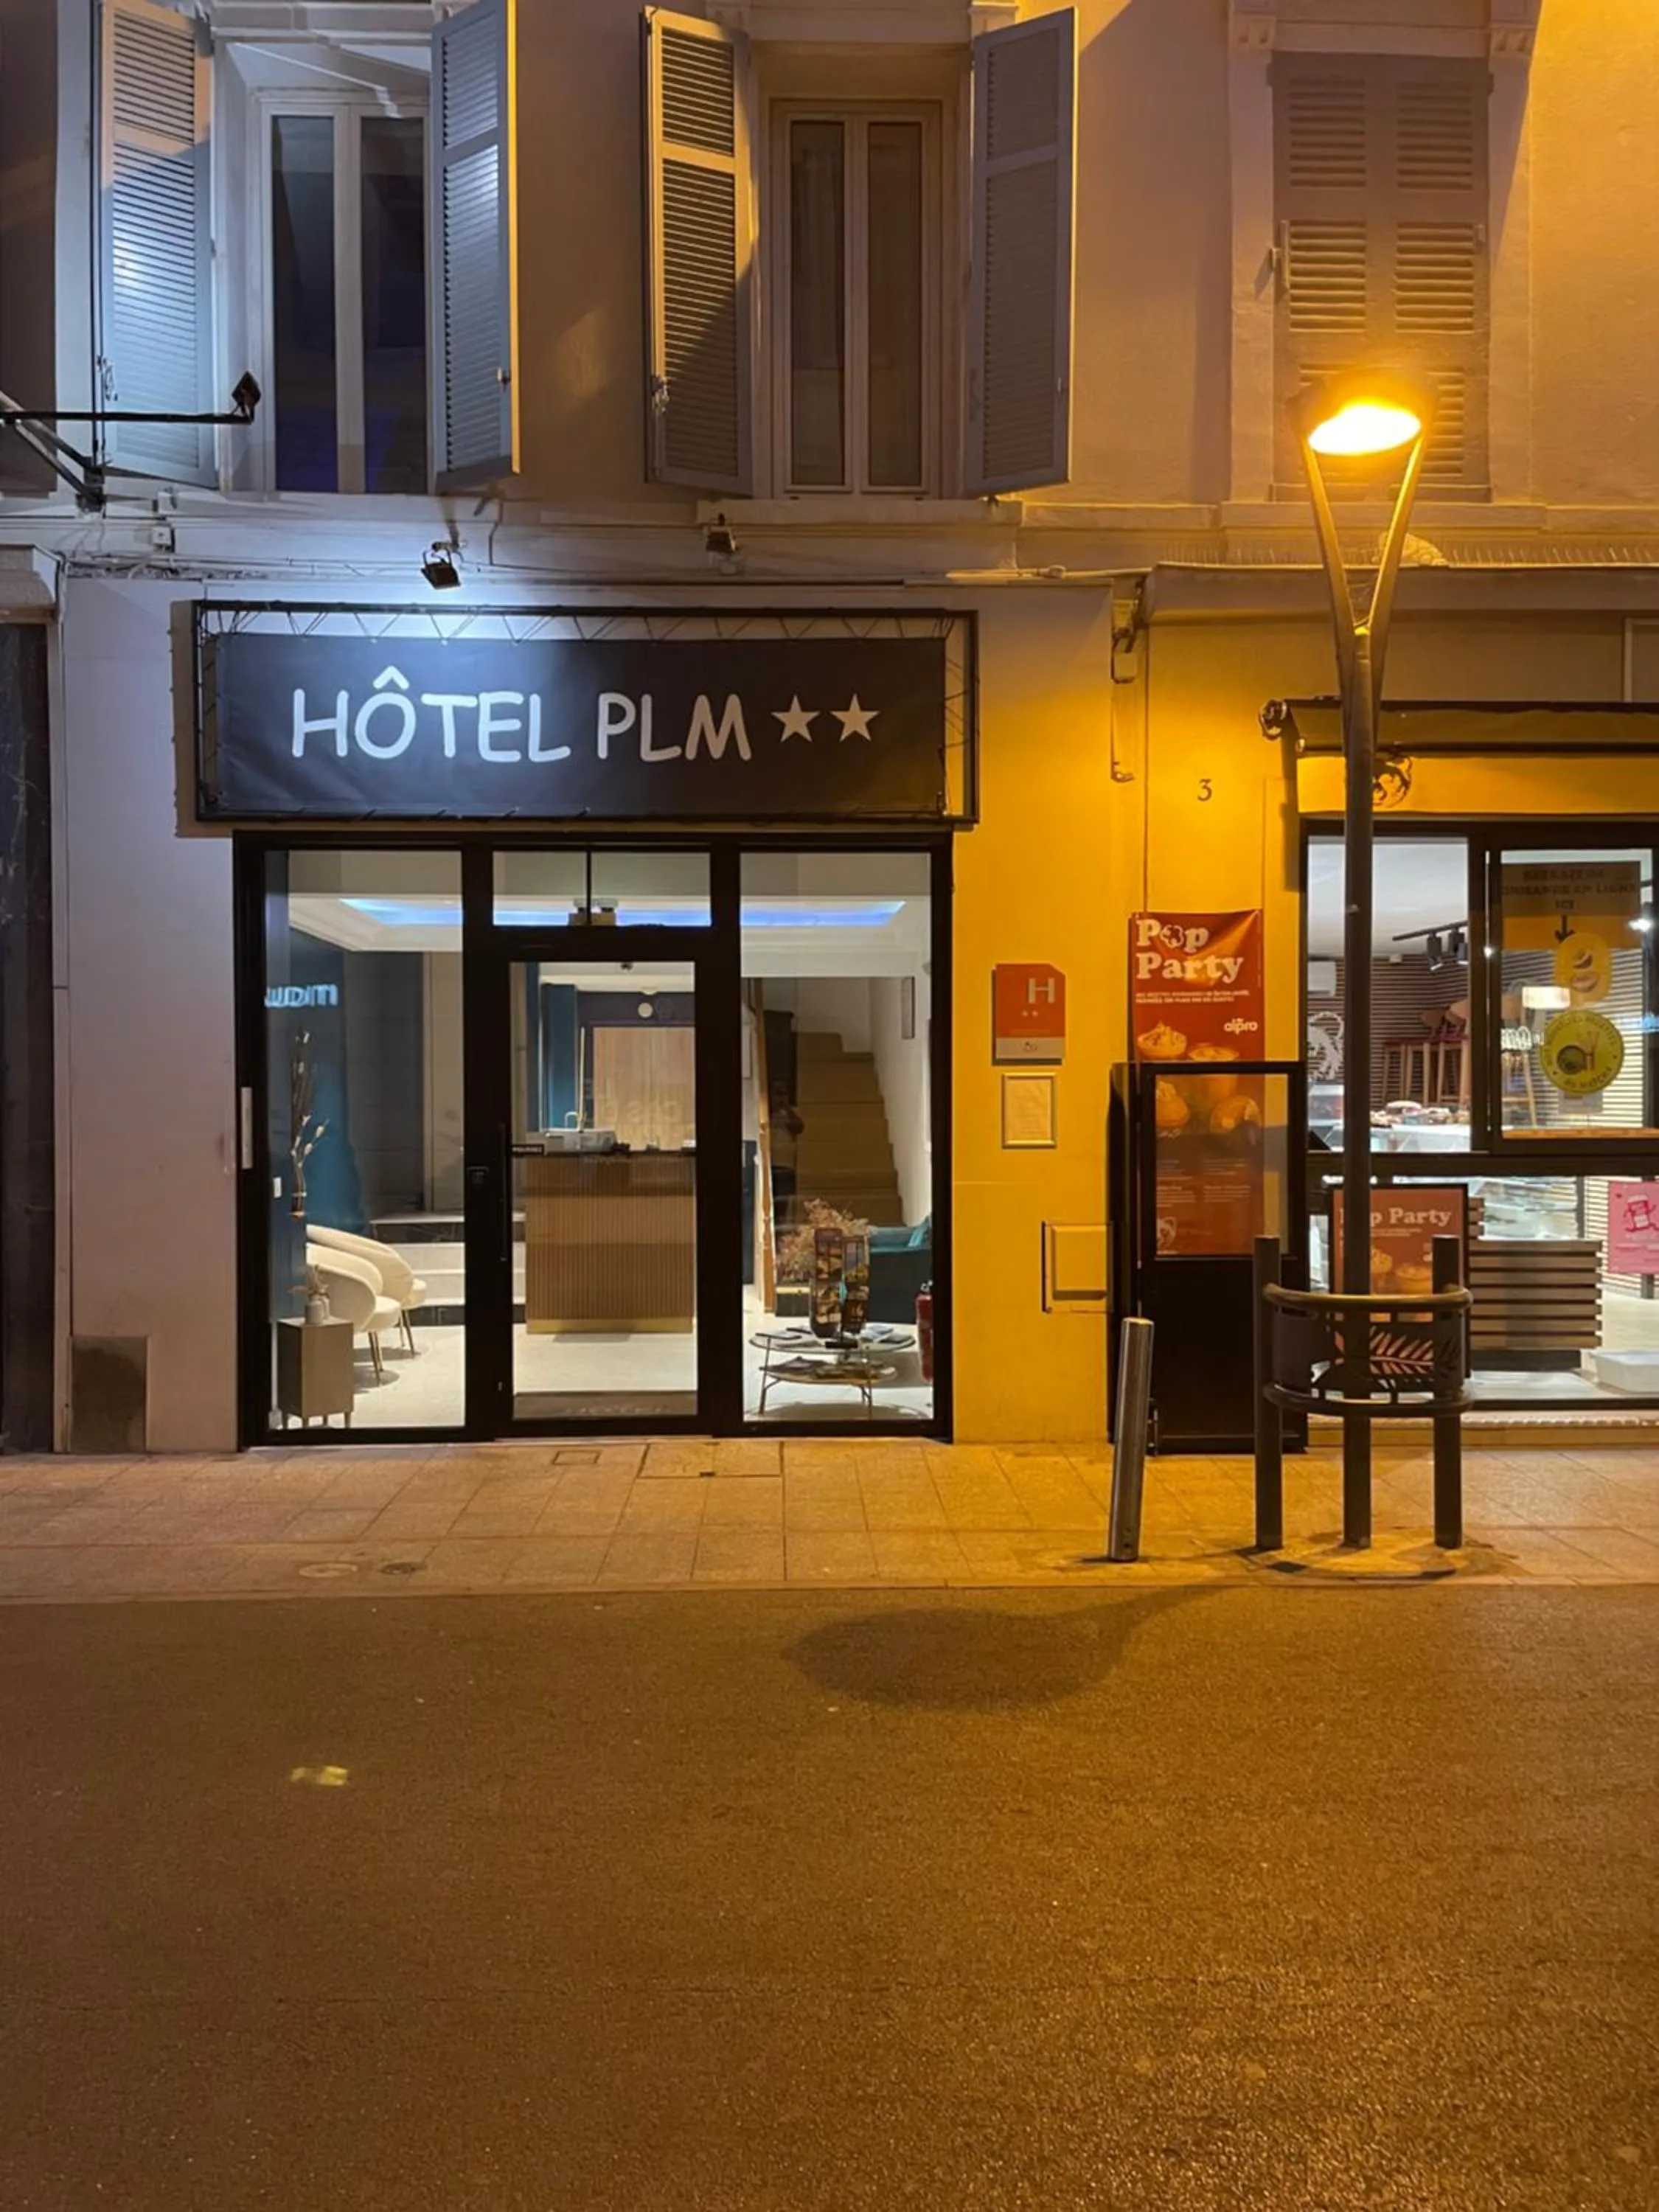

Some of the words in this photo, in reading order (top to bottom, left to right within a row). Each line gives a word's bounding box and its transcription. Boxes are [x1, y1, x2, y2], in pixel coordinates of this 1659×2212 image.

[292, 666, 570, 762] HÔTEL
[597, 692, 751, 762] PLM
[1197, 778, 1212, 802] 3
[1135, 919, 1209, 953] Pop
[1135, 952, 1244, 984] Party
[1028, 977, 1055, 1004] H
[1388, 1207, 1452, 1227] Party
